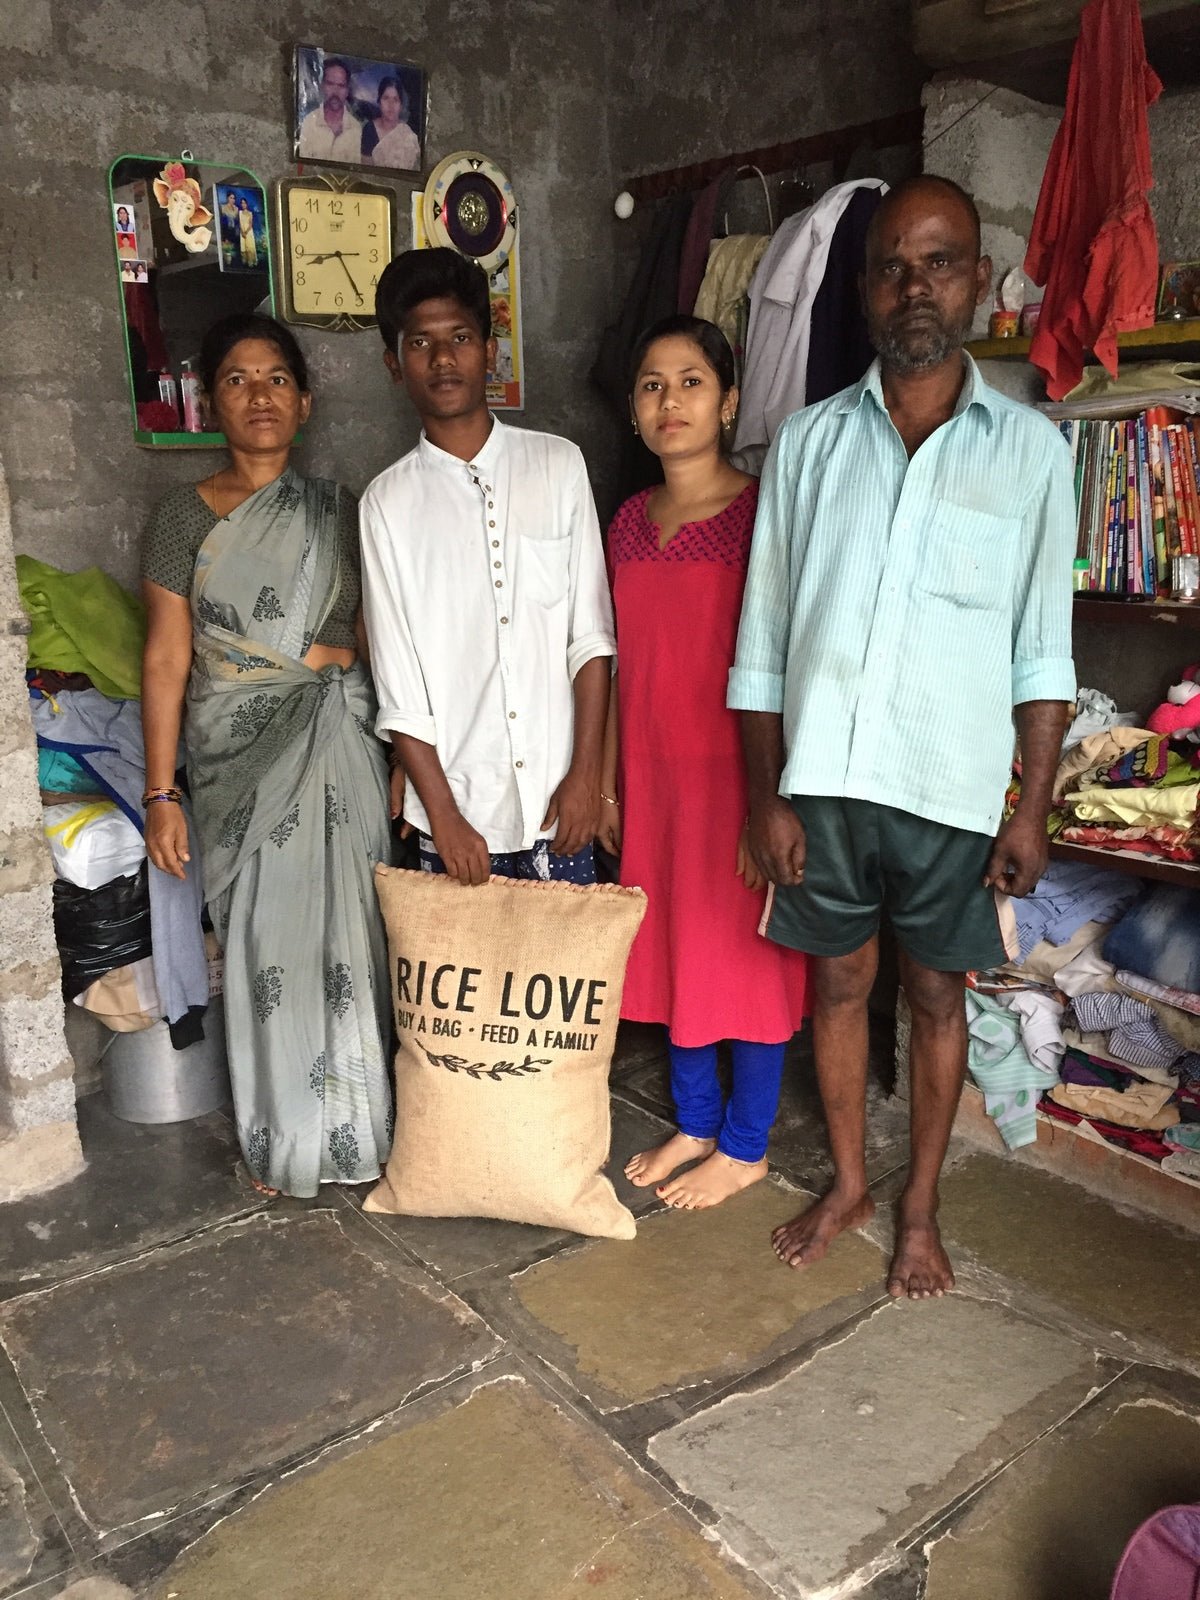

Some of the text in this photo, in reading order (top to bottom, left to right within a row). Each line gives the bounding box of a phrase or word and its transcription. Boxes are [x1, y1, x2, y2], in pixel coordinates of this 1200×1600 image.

[305, 198, 361, 217] 11 12 1
[291, 217, 308, 233] 10
[368, 223, 377, 238] 2
[295, 244, 305, 259] 9
[369, 248, 379, 264] 3
[296, 270, 306, 286] 8
[369, 274, 378, 287] 4
[313, 291, 364, 307] 7 6 5
[397, 956, 607, 1025] RICE LOVE
[398, 1009, 599, 1051] BUY A BAG FEED A FAMILY
